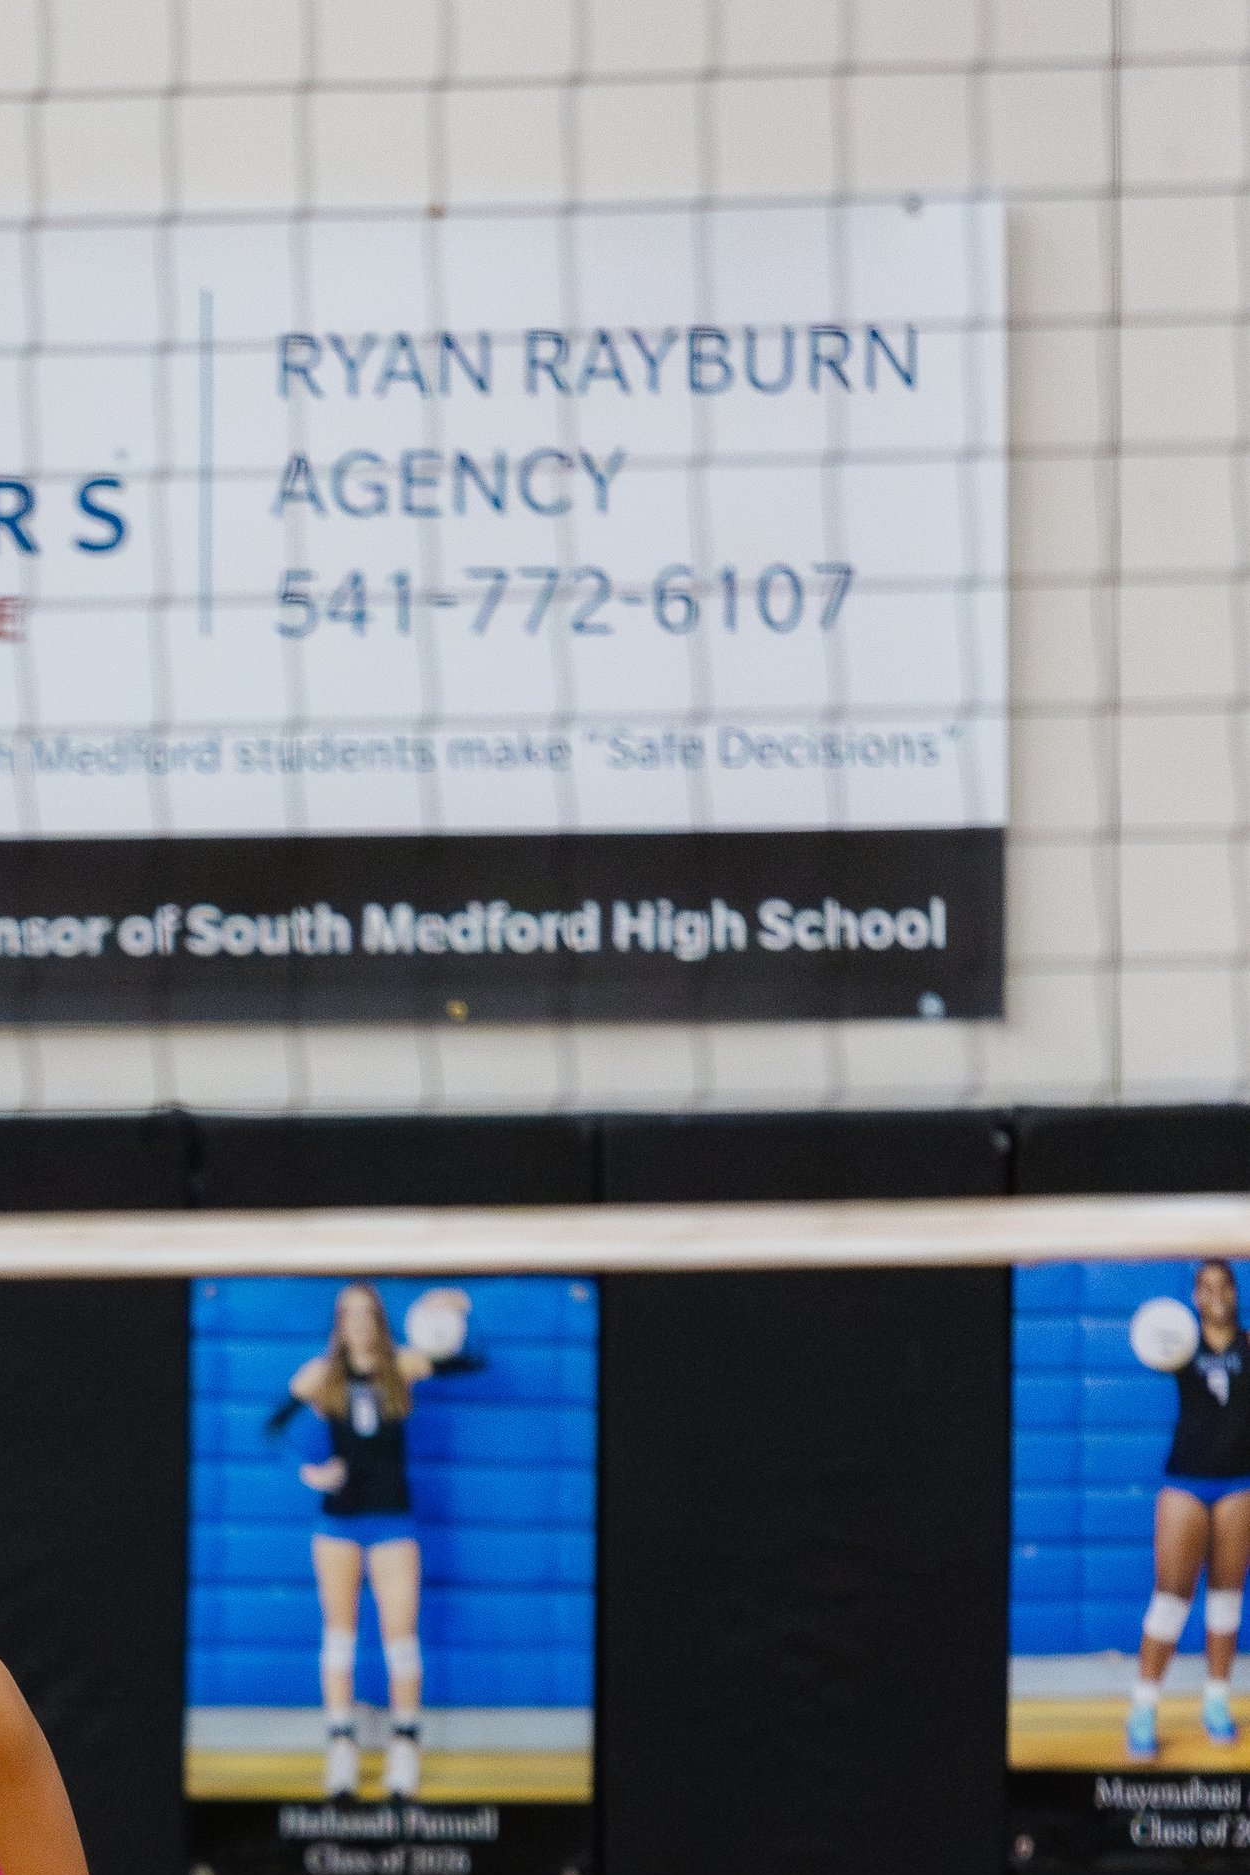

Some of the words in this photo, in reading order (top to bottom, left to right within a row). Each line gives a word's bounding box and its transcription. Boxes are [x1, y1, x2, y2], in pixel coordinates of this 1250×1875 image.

[276, 330, 492, 399] RYAN
[524, 323, 919, 397] RAYBURN
[271, 446, 628, 518] AGENCY
[275, 561, 855, 639] 541-772-6107
[30, 732, 222, 779] Medford
[233, 732, 436, 776] students
[446, 730, 573, 773] make
[118, 904, 179, 958] of
[185, 902, 351, 957] South
[362, 899, 601, 955] Medford
[613, 897, 747, 962] High
[756, 897, 947, 952] School
